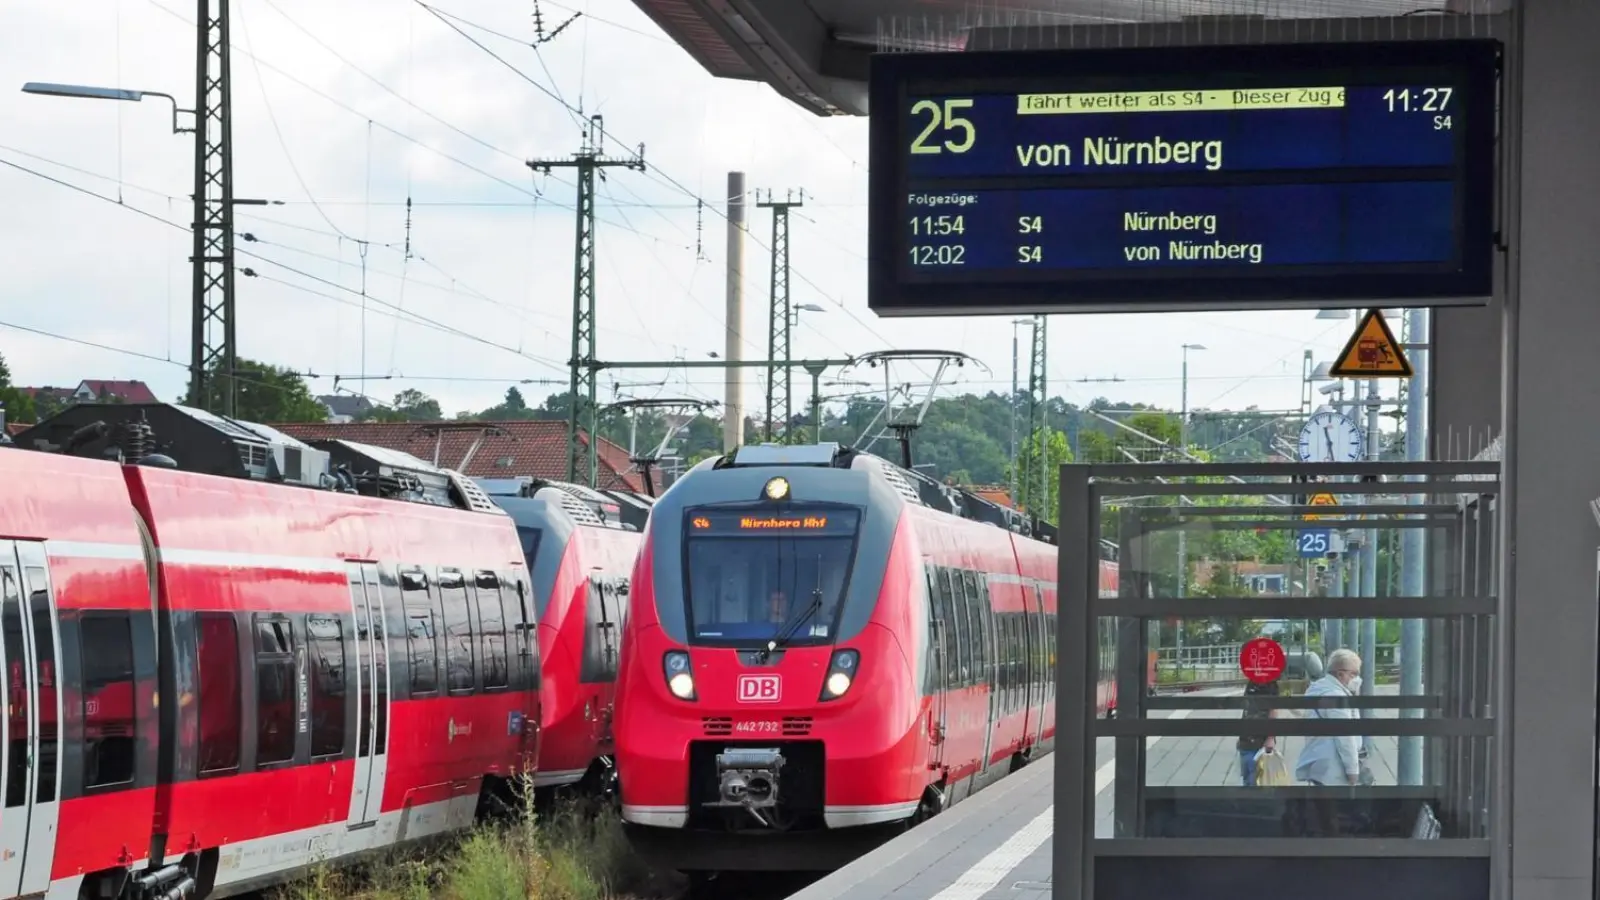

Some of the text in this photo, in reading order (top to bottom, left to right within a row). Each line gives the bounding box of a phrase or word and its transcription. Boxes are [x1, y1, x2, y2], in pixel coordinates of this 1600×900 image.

[1079, 93, 1142, 108] weiter
[1148, 92, 1177, 107] als
[1182, 91, 1204, 106] S4
[1232, 90, 1291, 105] Dieser
[1298, 89, 1331, 106] Zug
[1382, 87, 1453, 112] 11:27
[910, 98, 976, 154] 25
[1433, 115, 1452, 130] S4
[1016, 136, 1223, 170] von Nürnberg
[908, 192, 979, 207] Folgezüge:
[910, 211, 1217, 236] 11:54 S4 Nürnberg
[910, 240, 1262, 265] 12:02 S4 von Nürnberg
[1302, 533, 1326, 552] 25
[743, 679, 776, 698] DB
[736, 721, 778, 732] 442 732
